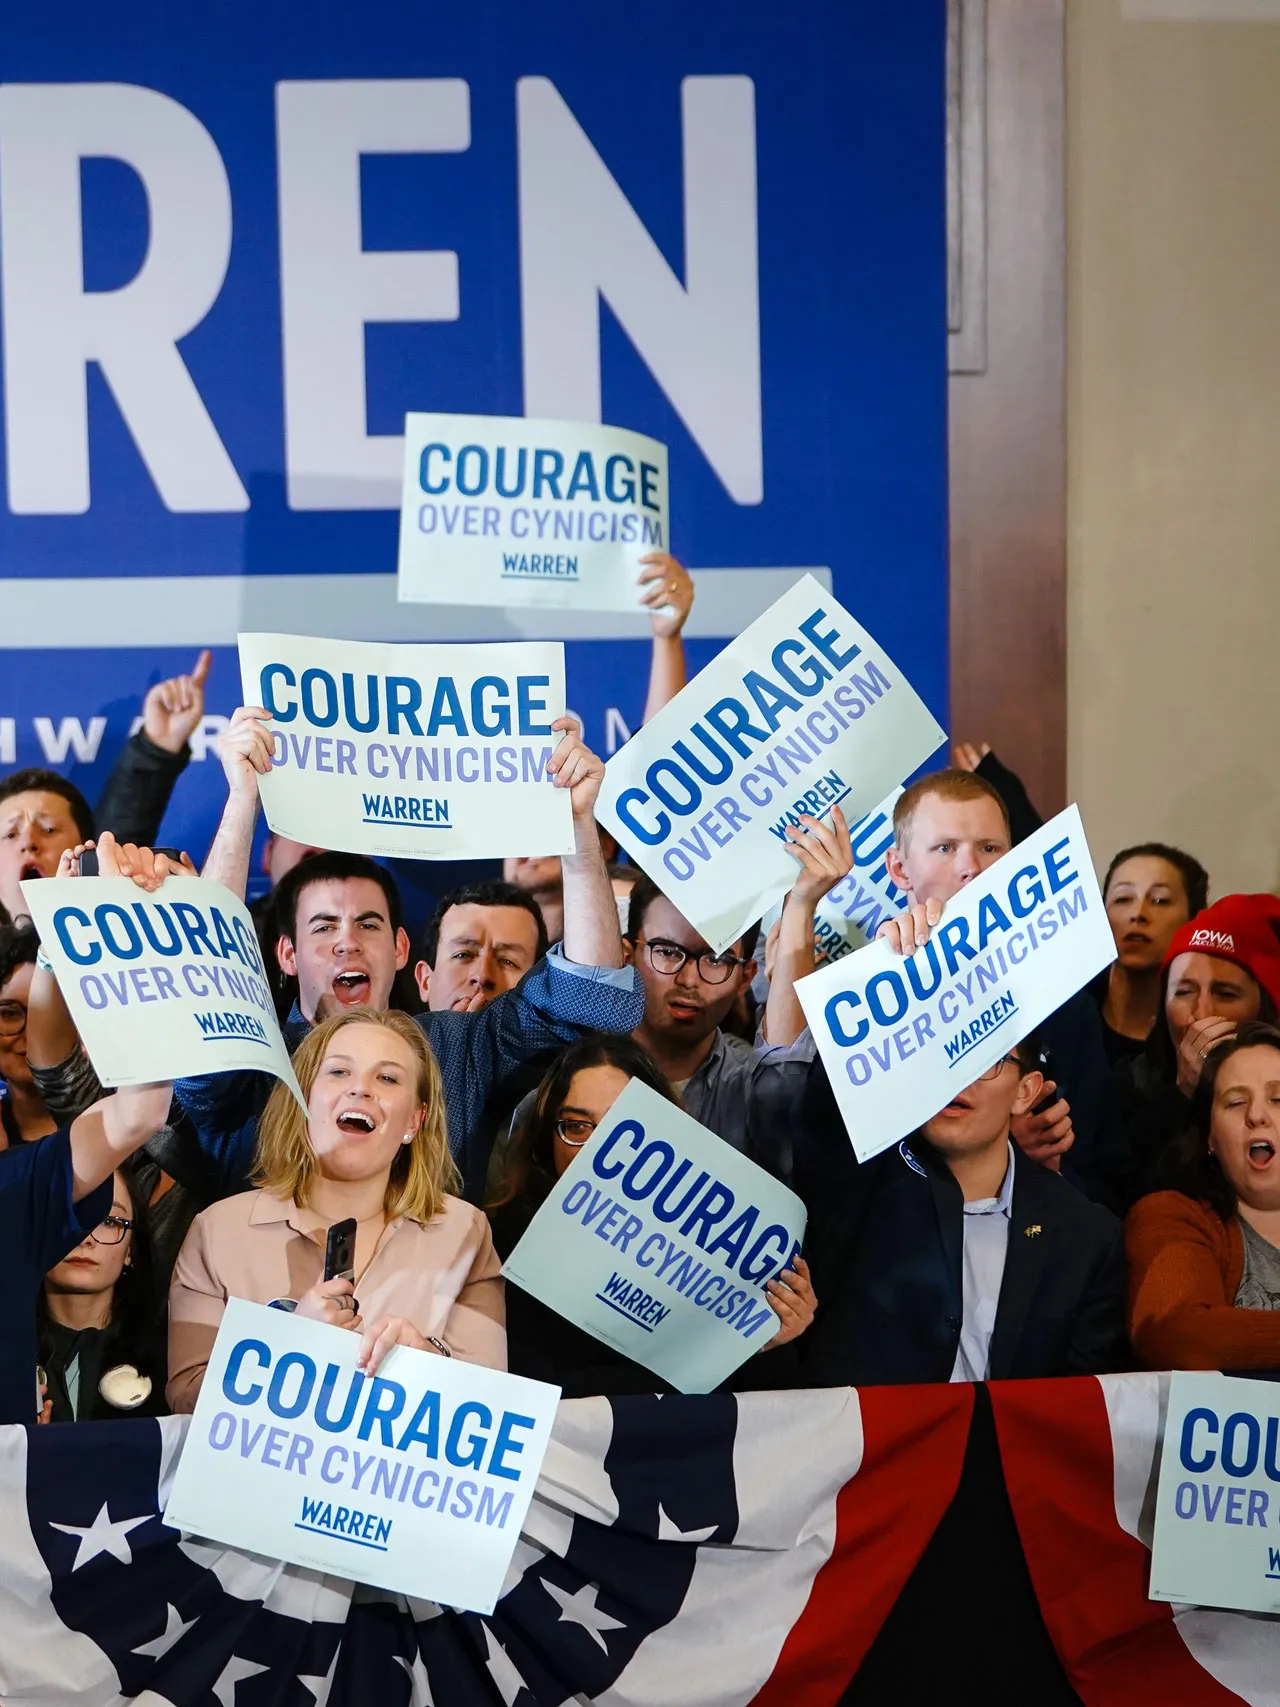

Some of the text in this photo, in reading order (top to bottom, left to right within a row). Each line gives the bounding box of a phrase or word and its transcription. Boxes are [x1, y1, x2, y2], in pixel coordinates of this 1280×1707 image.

[419, 443, 661, 513] COURAGE
[418, 503, 663, 548] OVER CYNICISM
[502, 552, 579, 575] WARREN
[260, 663, 552, 737] COURAGE
[616, 608, 862, 845] COURAGE
[270, 730, 554, 783] OVER CYNICISM
[663, 796, 752, 881] OVER
[740, 660, 892, 807] CYNICISM
[362, 794, 449, 822] WARREN
[768, 769, 847, 842] WARREN
[824, 836, 1079, 1047] COURAGE
[1191, 929, 1235, 947] IOWA
[80, 966, 182, 1010] OVER
[846, 1012, 935, 1086] OVER
[938, 885, 1088, 1024] CYNICISM
[194, 1012, 267, 1039] WARREN
[944, 990, 1015, 1060] WARREN
[562, 1180, 772, 1338] OVER CYNICISM
[603, 1272, 671, 1327] WARREN
[222, 1338, 535, 1481] COURAGE
[208, 1411, 514, 1529] OVER CYNICISM
[1175, 1482, 1269, 1528] OVER
[301, 1496, 392, 1543] WARREN
